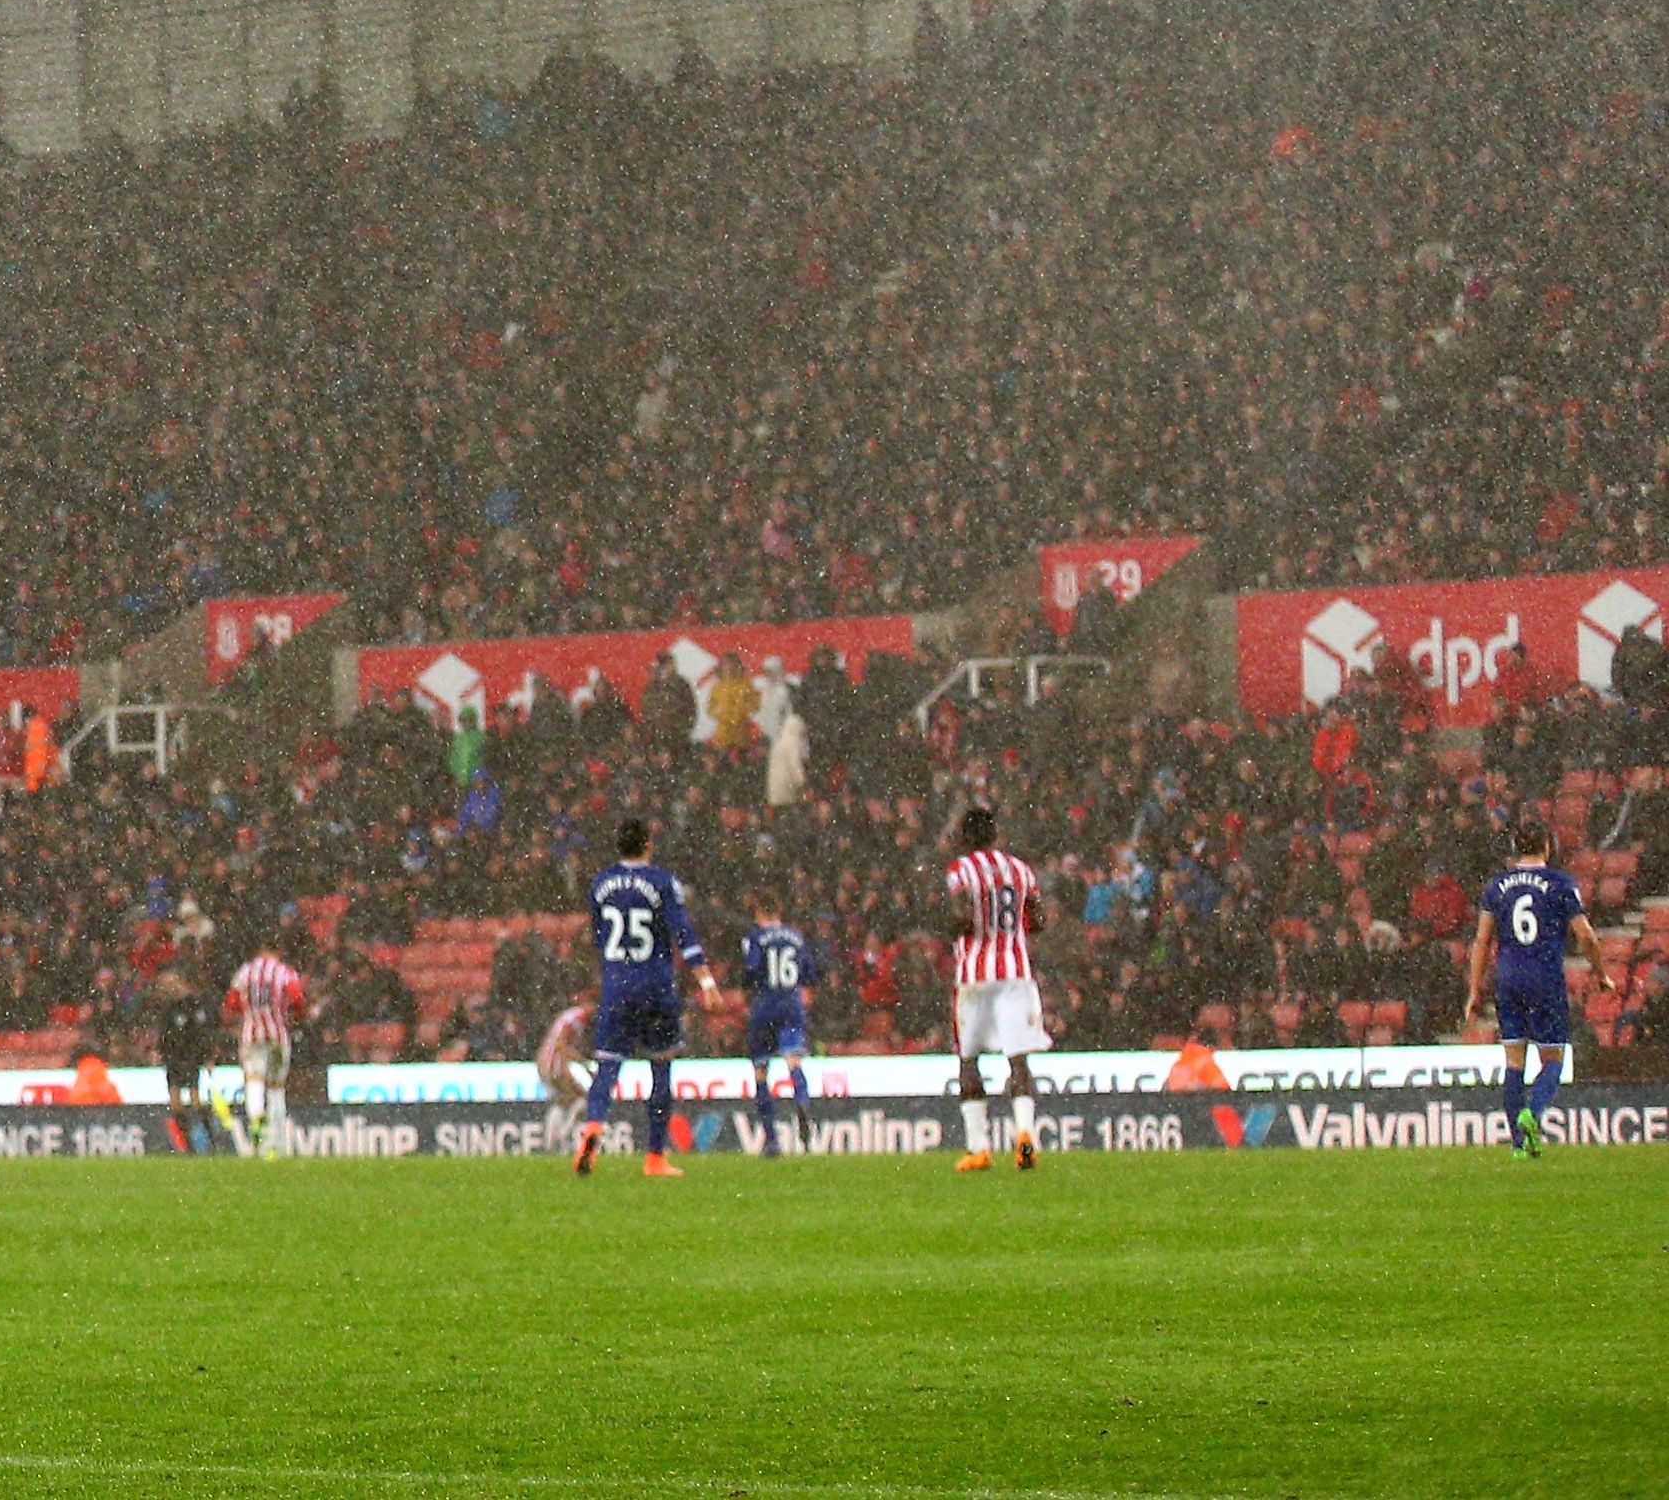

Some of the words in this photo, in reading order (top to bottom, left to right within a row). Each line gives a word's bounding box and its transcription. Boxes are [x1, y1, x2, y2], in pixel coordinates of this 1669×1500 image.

[1408, 612, 1522, 707] dpd
[601, 904, 654, 963] 25
[1512, 893, 1538, 946] 6
[767, 945, 799, 990] 16
[434, 1120, 542, 1156] SINCE
[1096, 1114, 1184, 1151] 1866
[1287, 1101, 1513, 1149] Valvoline
[1542, 1106, 1669, 1147] SINCE
